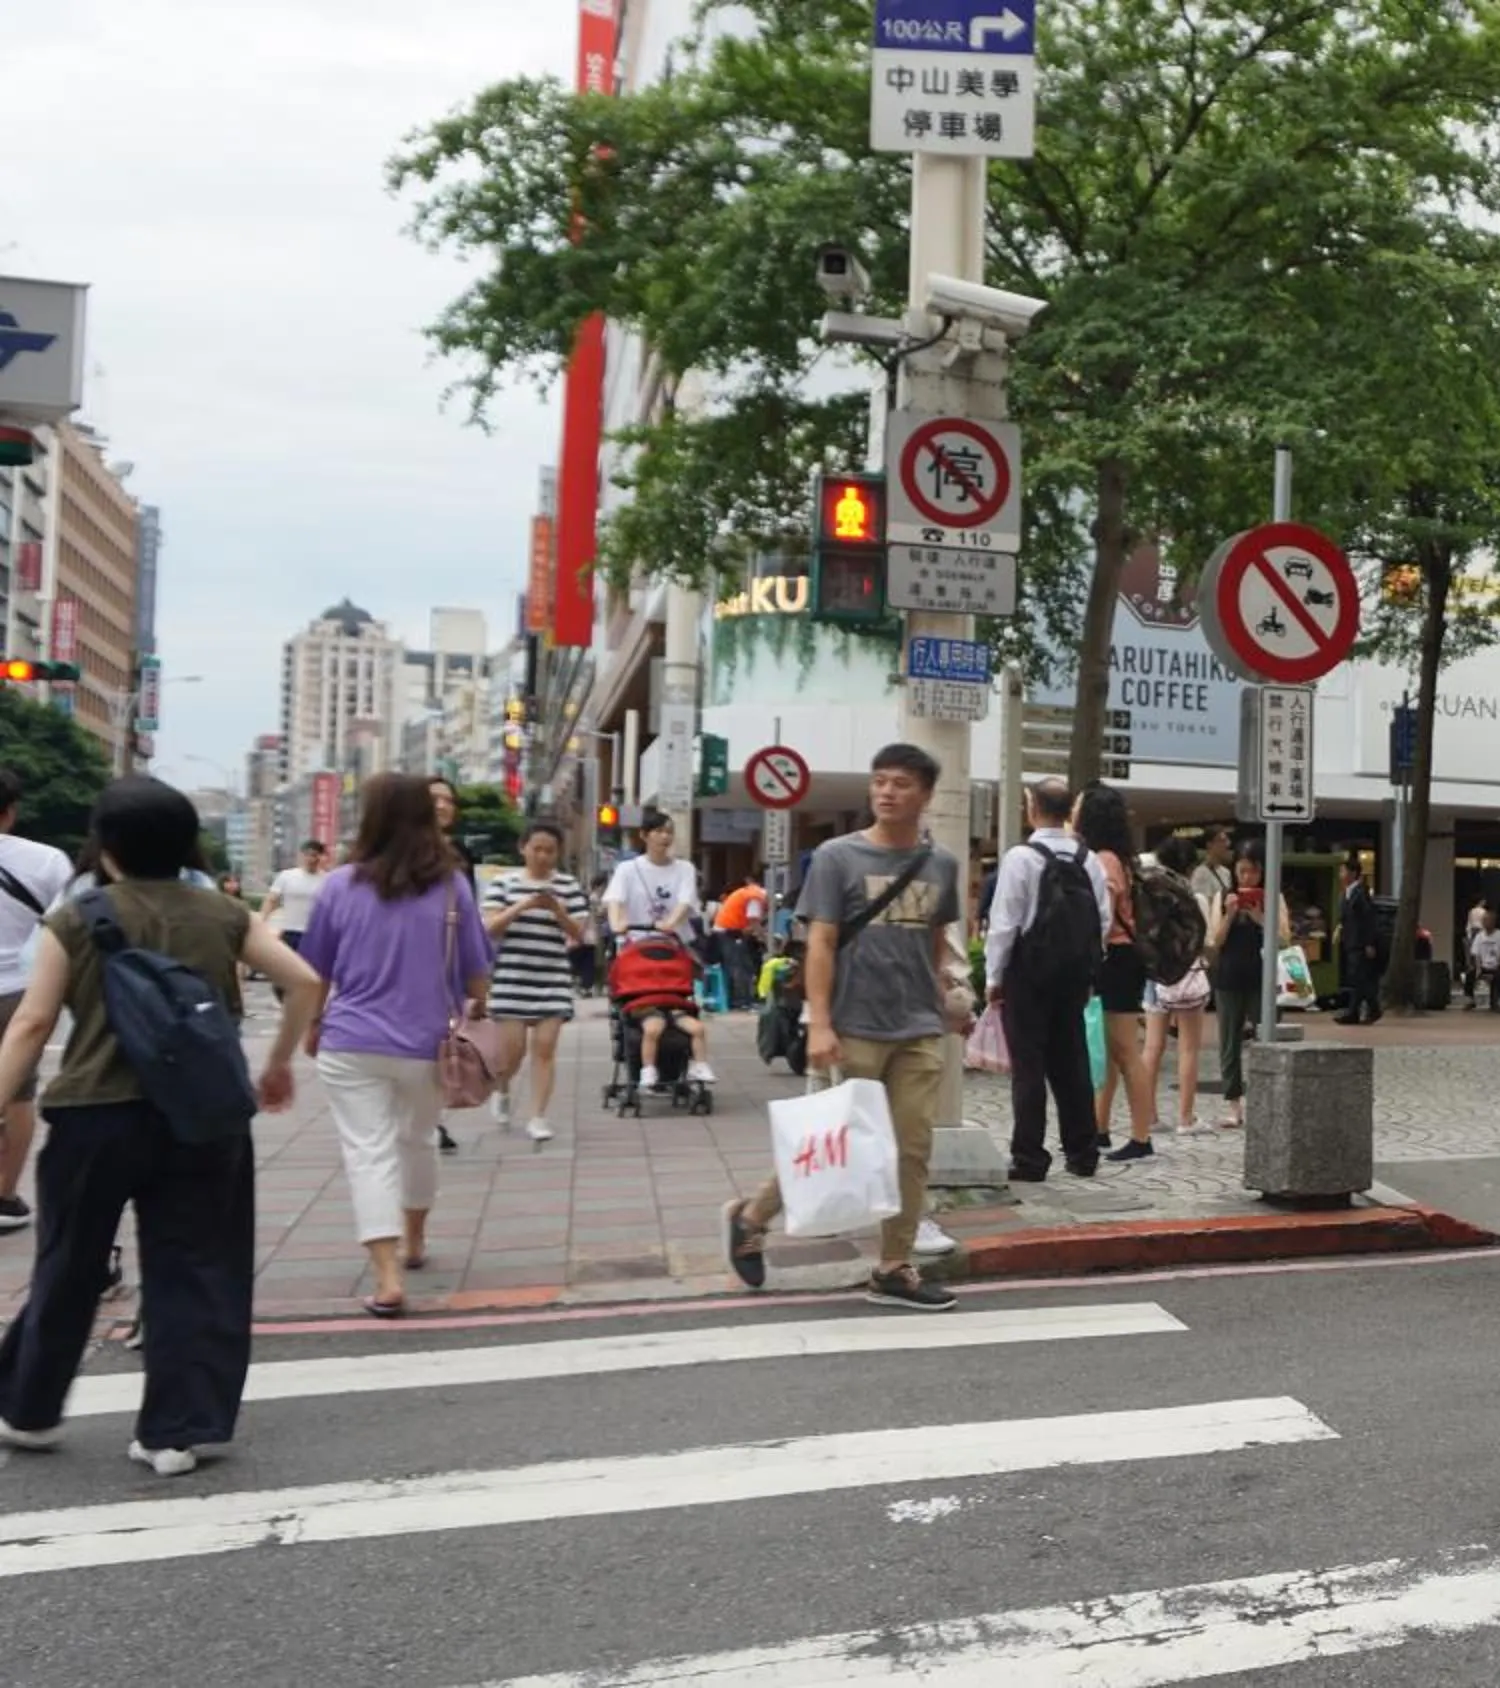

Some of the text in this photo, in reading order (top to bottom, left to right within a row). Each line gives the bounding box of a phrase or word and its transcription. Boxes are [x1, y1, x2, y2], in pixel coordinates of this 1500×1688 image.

[882, 19, 964, 43] 100公尺
[886, 65, 1020, 98] 中山美學
[902, 109, 1002, 142] 停車場
[927, 444, 985, 503] 停
[958, 531, 991, 548] 110
[1108, 644, 1238, 683] ARUTAHIKO
[1121, 677, 1209, 711] COFFEE
[793, 1123, 850, 1178] H&M
